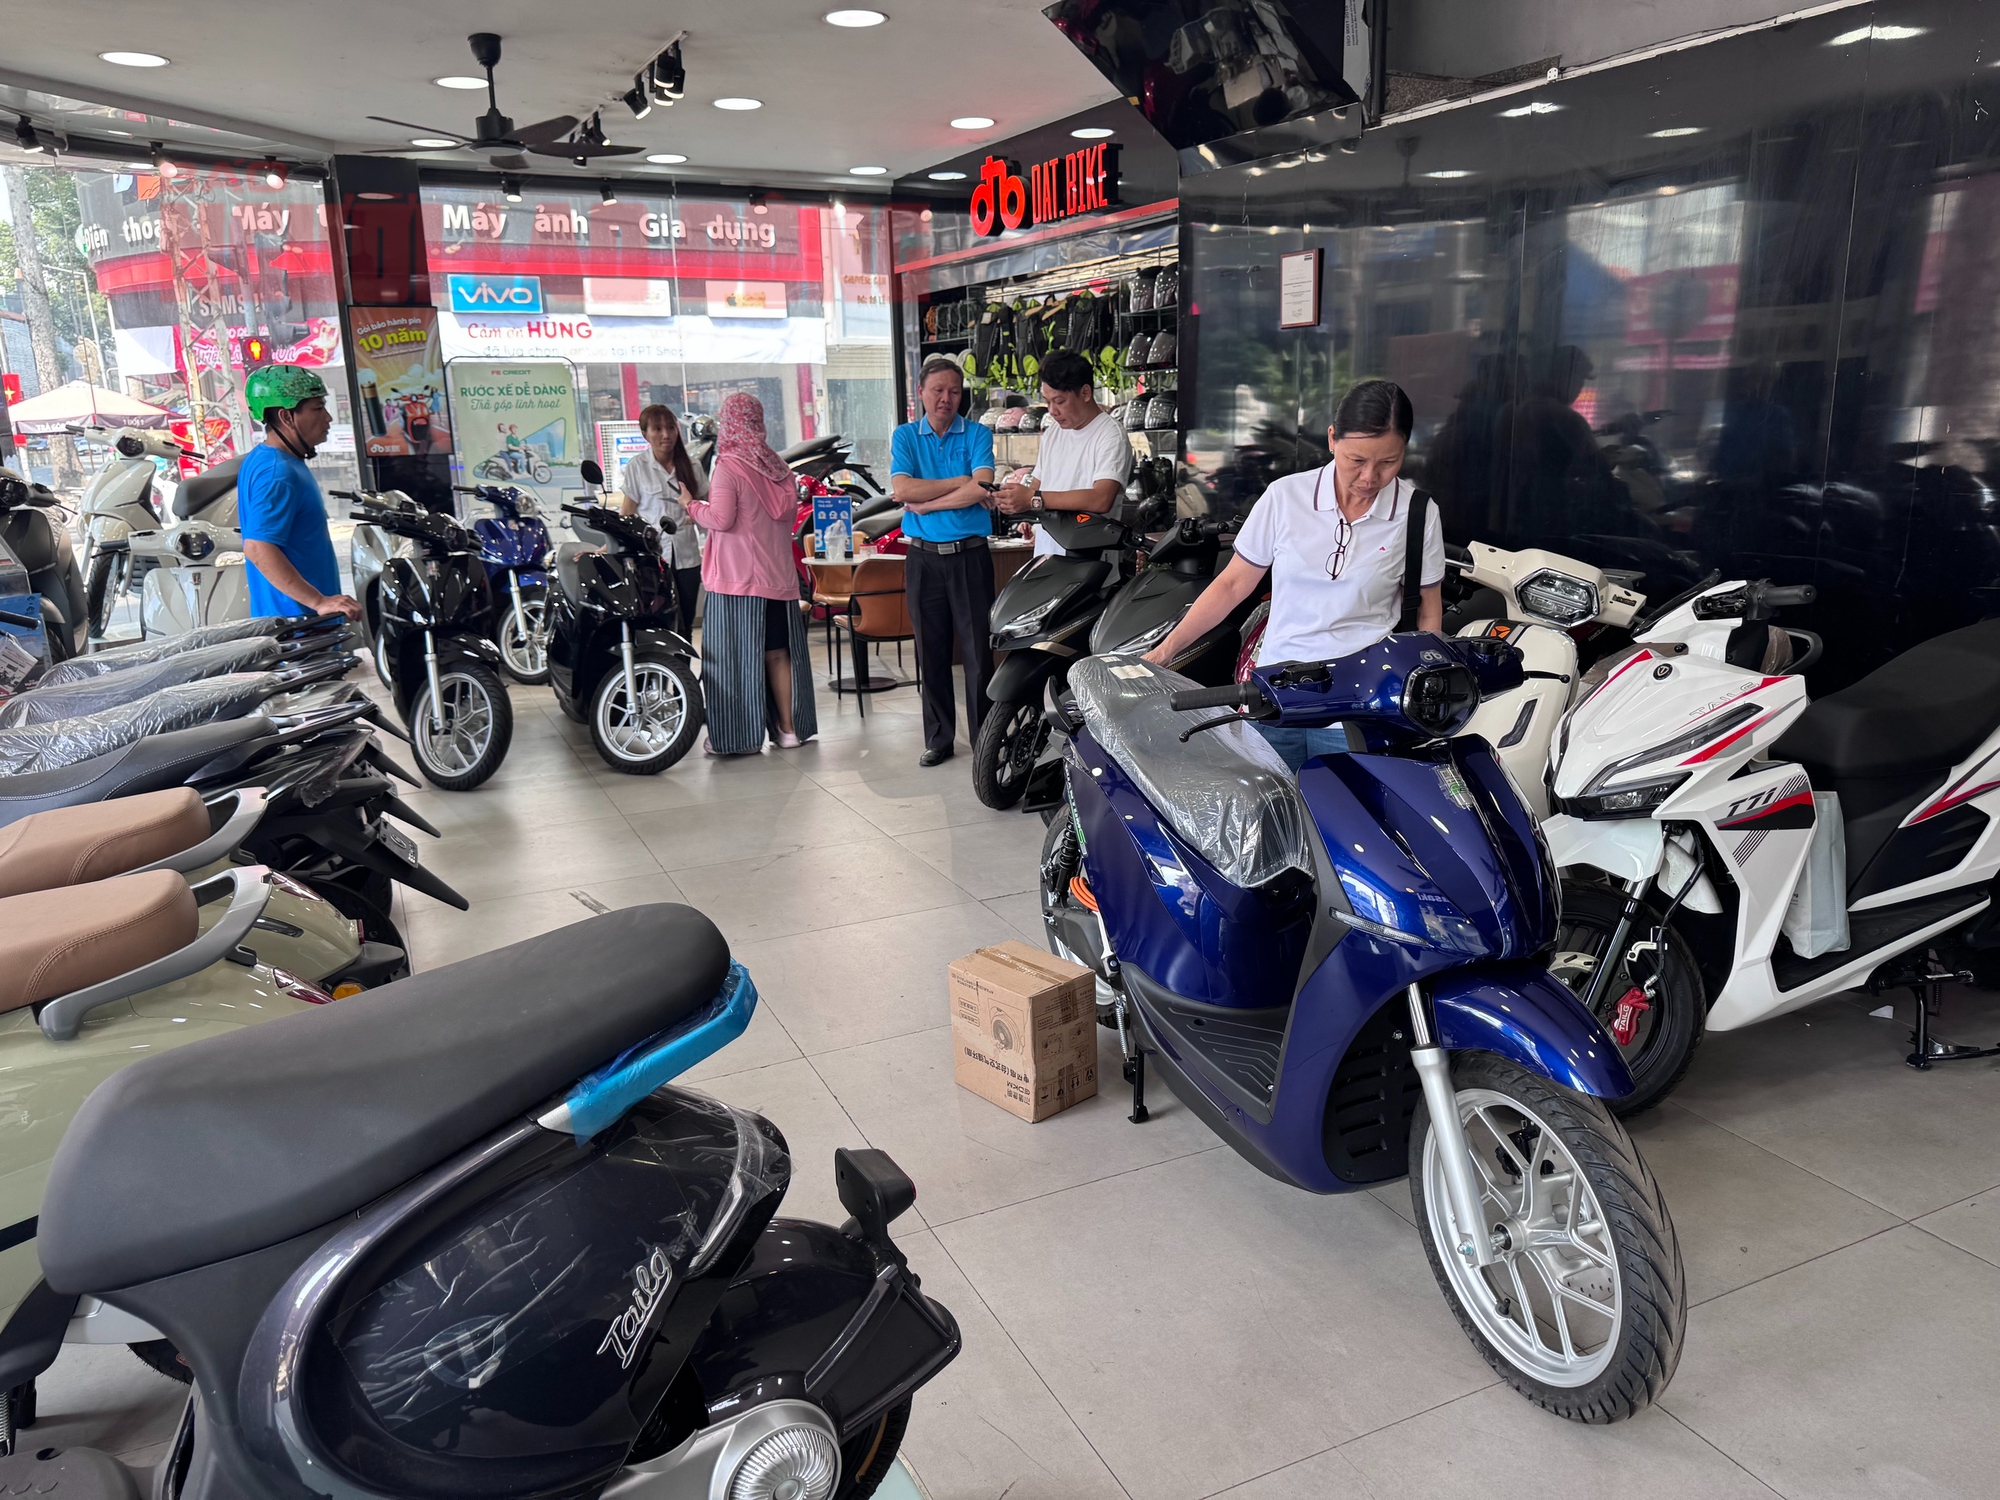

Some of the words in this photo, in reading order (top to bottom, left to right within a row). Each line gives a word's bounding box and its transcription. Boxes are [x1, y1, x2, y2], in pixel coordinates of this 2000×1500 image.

[232, 202, 290, 236] Máy
[442, 203, 507, 239] Máy
[535, 204, 588, 234] ảnh
[639, 213, 687, 238] Gia
[706, 214, 776, 248] dụng
[458, 282, 533, 304] vivo
[358, 333, 384, 352] 10
[385, 328, 428, 345] năm
[631, 346, 653, 356] FPT
[460, 384, 495, 397] RƯỚC
[534, 383, 567, 396] DÀNG
[471, 399, 492, 411] Trả
[494, 400, 513, 413] góp
[515, 399, 535, 409] linh
[537, 399, 561, 411] hoạt
[1619, 1004, 1630, 1031] TAILG
